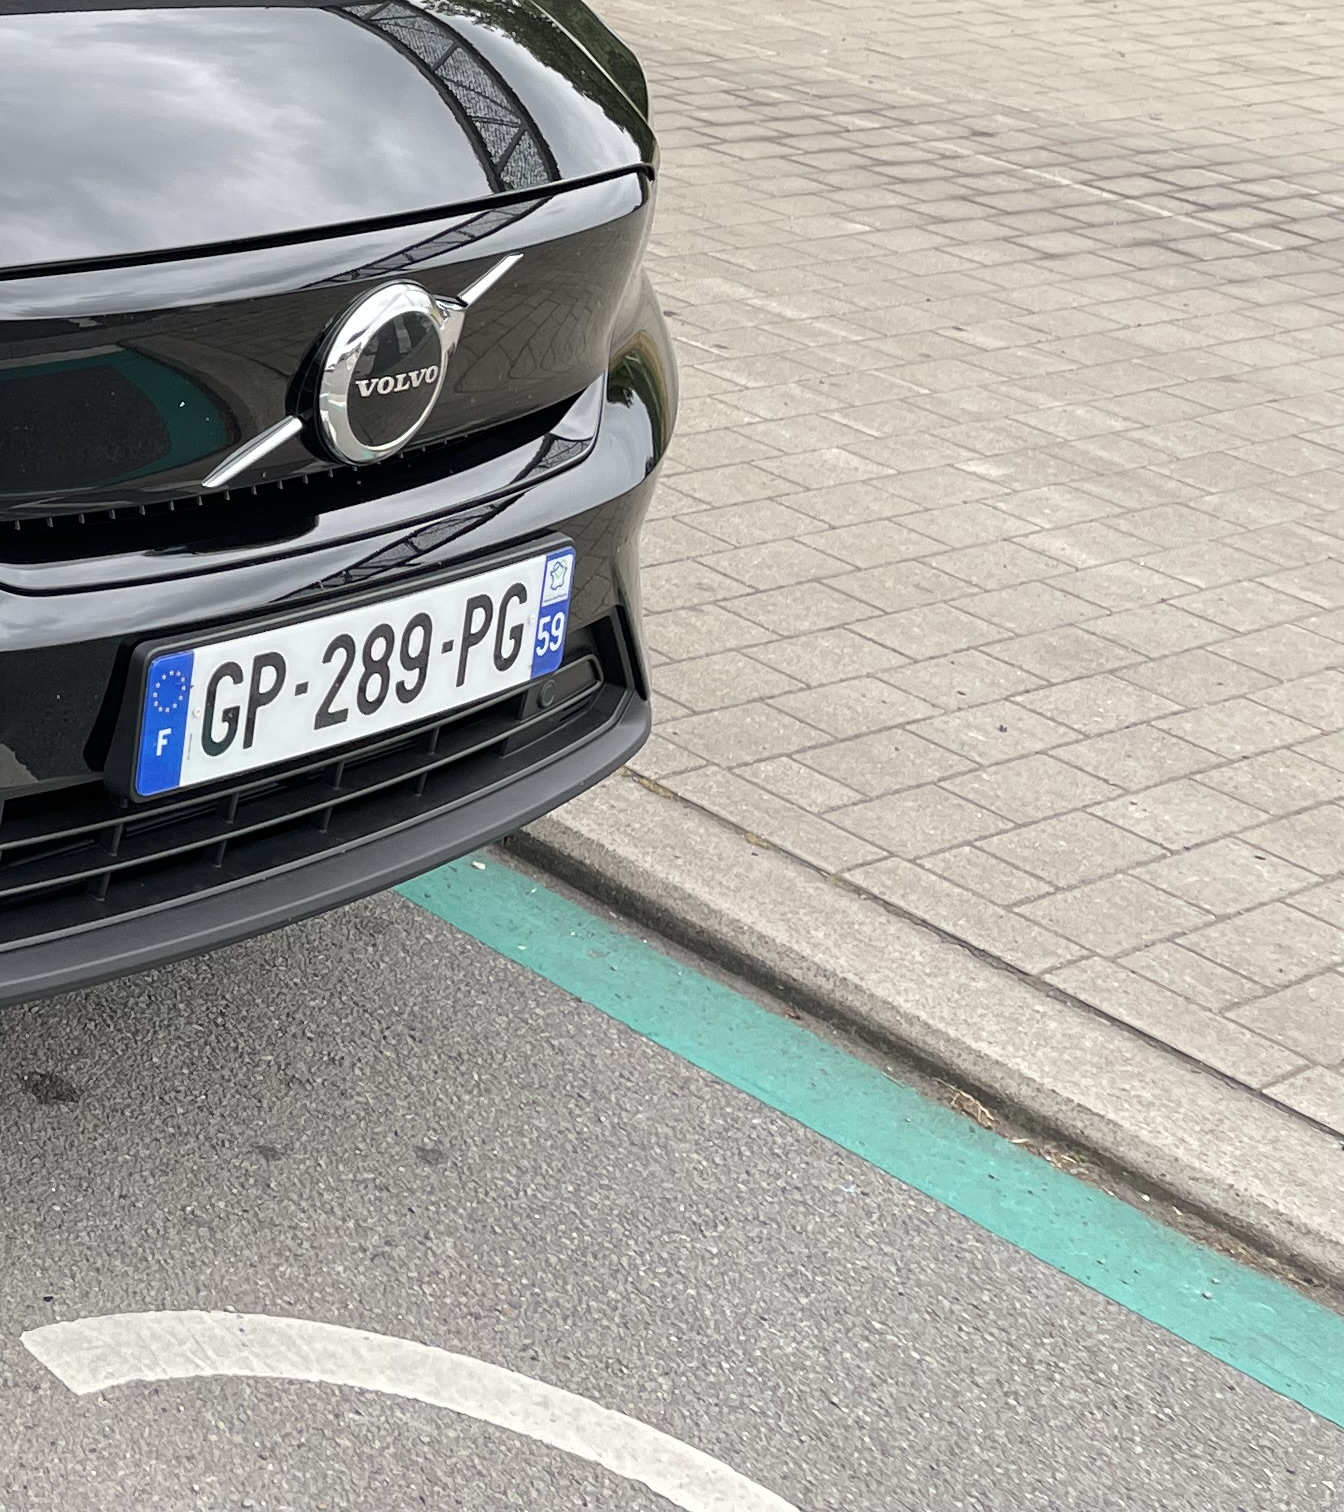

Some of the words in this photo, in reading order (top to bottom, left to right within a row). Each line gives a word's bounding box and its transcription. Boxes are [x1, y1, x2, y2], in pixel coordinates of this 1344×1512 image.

[355, 365, 439, 397] VOLVO
[536, 611, 565, 657] 59
[200, 582, 528, 756] GP-289-PG
[156, 728, 172, 757] F
